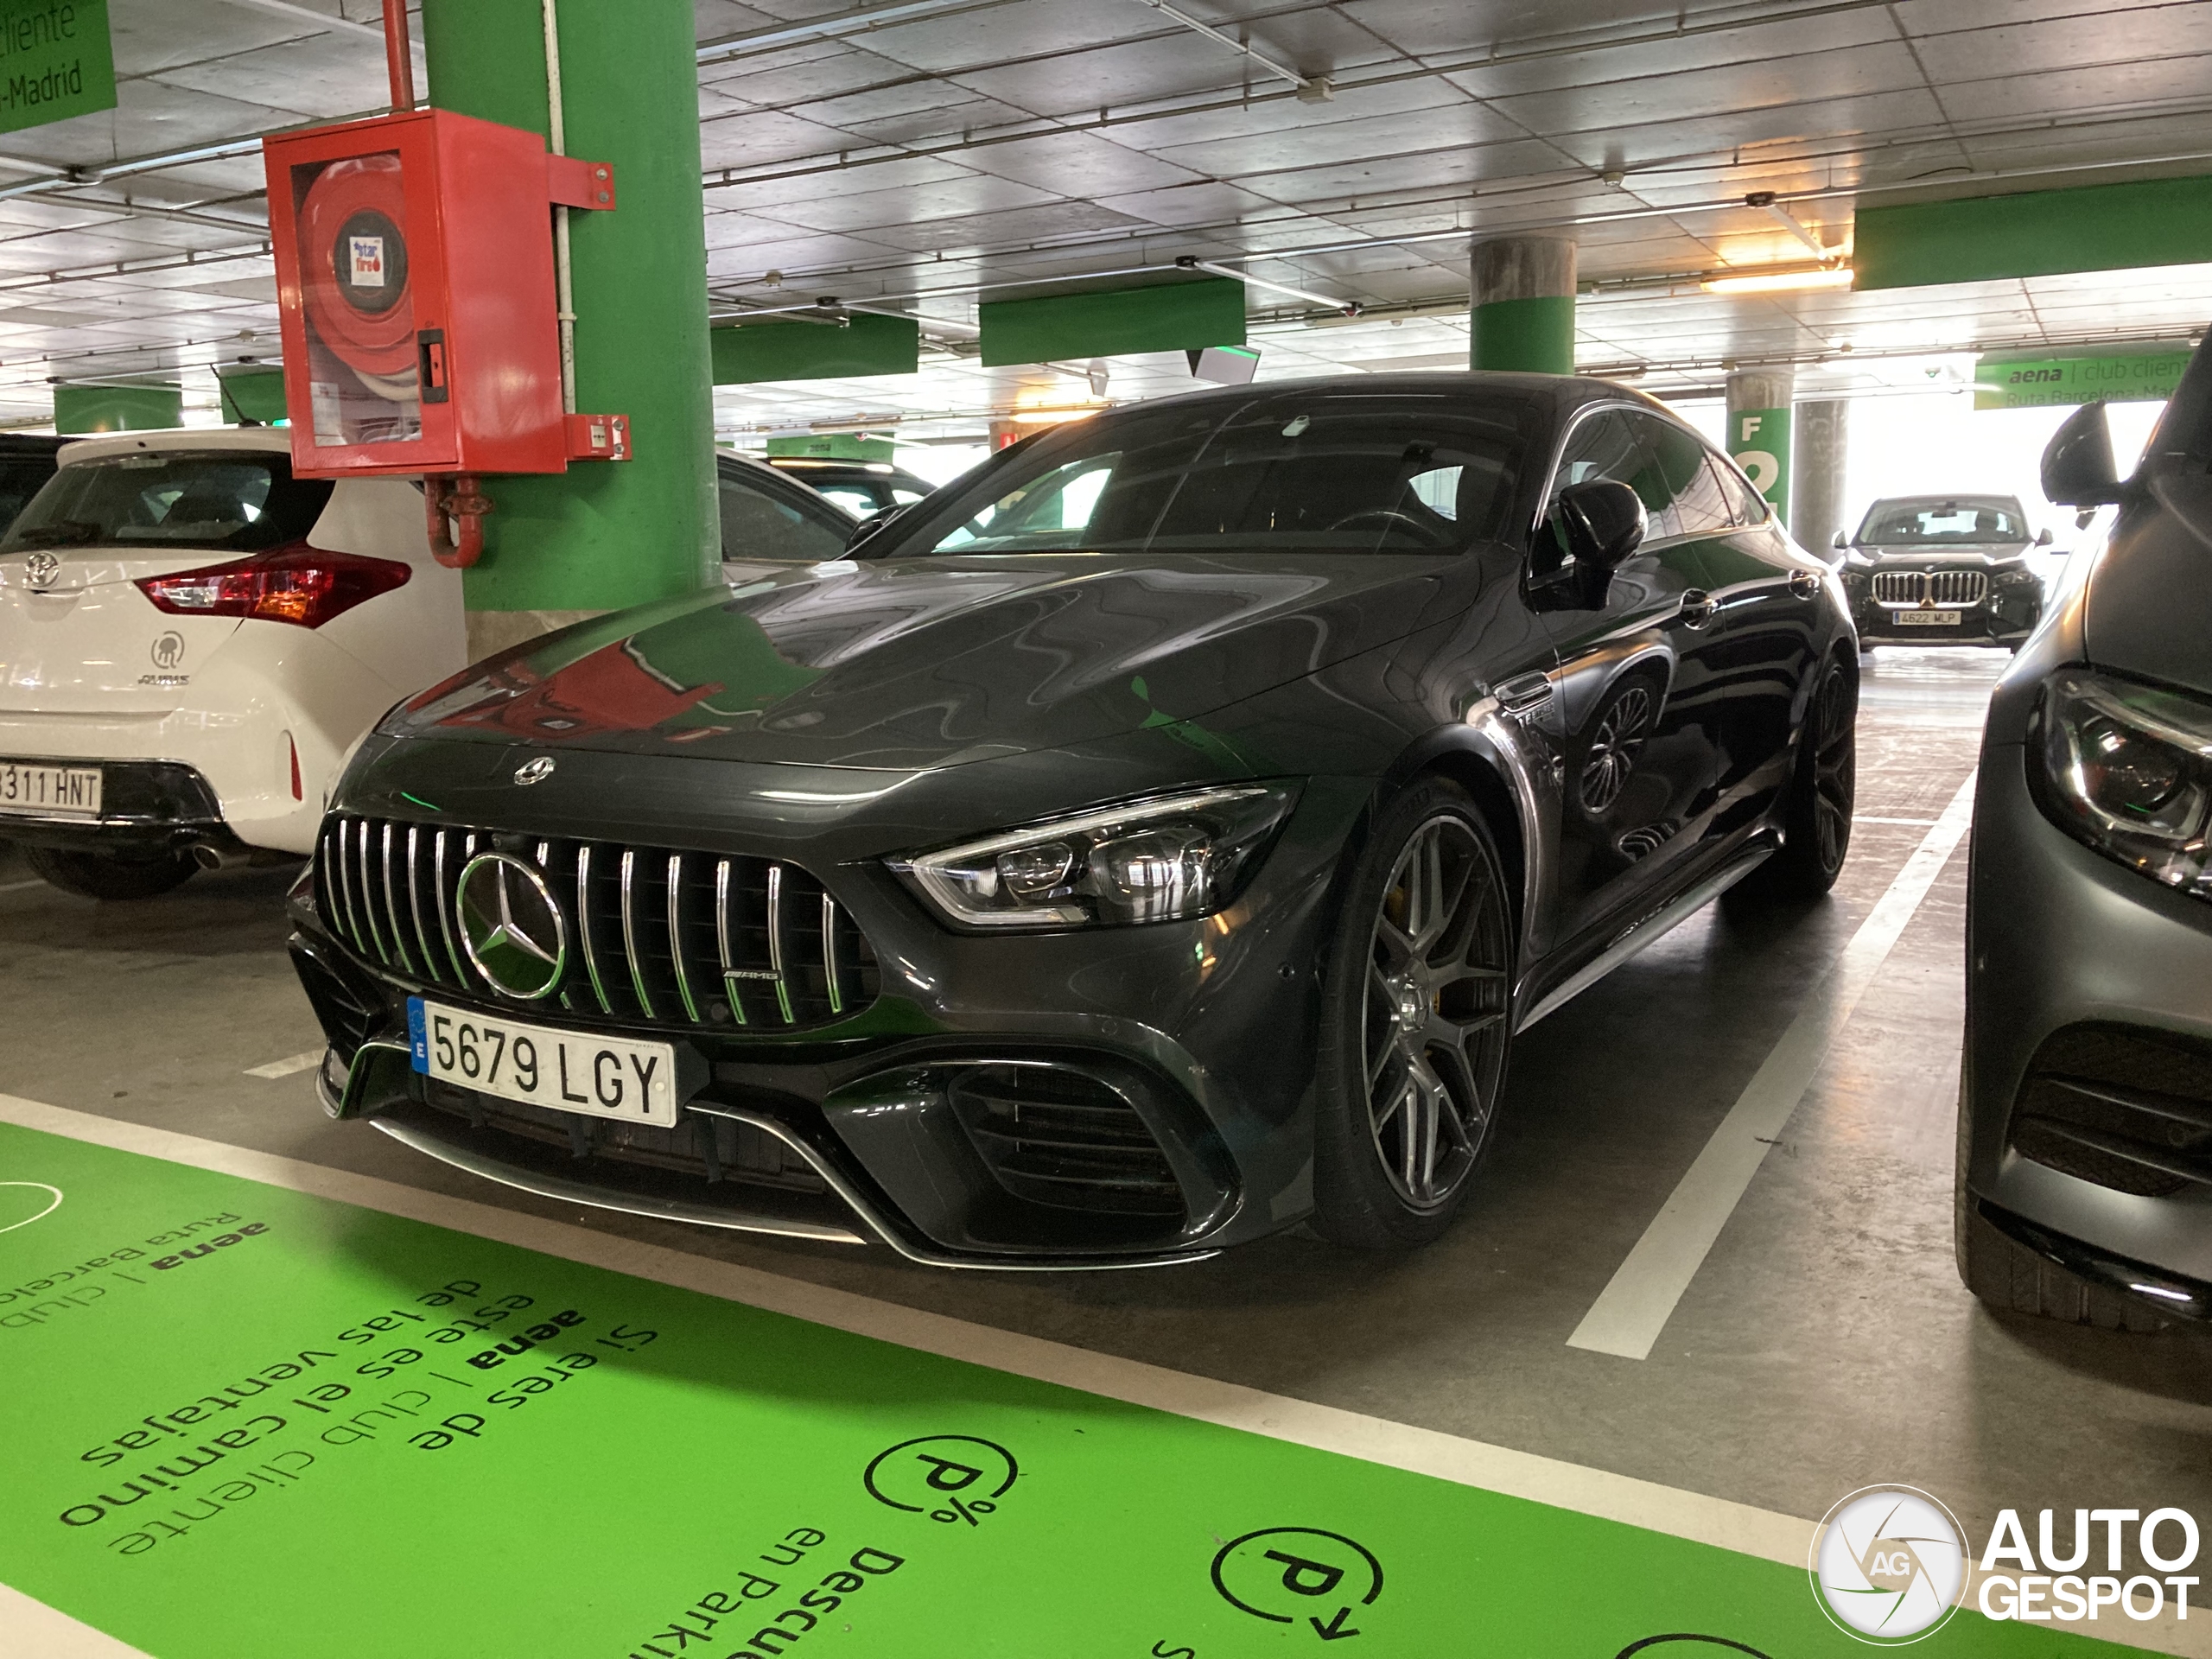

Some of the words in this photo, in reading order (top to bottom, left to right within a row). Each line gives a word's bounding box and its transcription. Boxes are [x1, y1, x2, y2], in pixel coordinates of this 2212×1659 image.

[0, 2, 76, 58] liente
[356, 257, 372, 272] fire
[2009, 367, 2063, 384] aena
[2084, 359, 2127, 381] club
[2133, 357, 2189, 378] clien
[2007, 392, 2046, 407] Ruta
[1741, 416, 1763, 442] F
[1902, 613, 1929, 623] 4622
[1934, 613, 1955, 623] MLP
[0, 767, 45, 803] 311
[55, 771, 98, 806] HNT
[741, 971, 779, 980] AMG
[416, 1041, 425, 1058] E
[433, 1014, 538, 1093] 5679
[558, 1043, 658, 1114] LGY
[145, 1212, 242, 1245] Ruta
[149, 1222, 270, 1270] aena
[0, 1287, 106, 1328] club
[416, 1280, 481, 1306] de
[337, 1309, 426, 1345] las
[424, 1294, 535, 1344] este
[595, 1324, 658, 1352] Si
[466, 1309, 587, 1370] aena
[356, 1348, 423, 1379] es
[486, 1352, 598, 1409] eres
[80, 1350, 338, 1468] ventajas
[291, 1382, 352, 1414] el
[321, 1389, 431, 1445] club
[407, 1413, 486, 1450] de
[59, 1414, 287, 1527] camino
[107, 1450, 315, 1554] cliente
[759, 1527, 826, 1566] en
[628, 1571, 781, 1659] Parki
